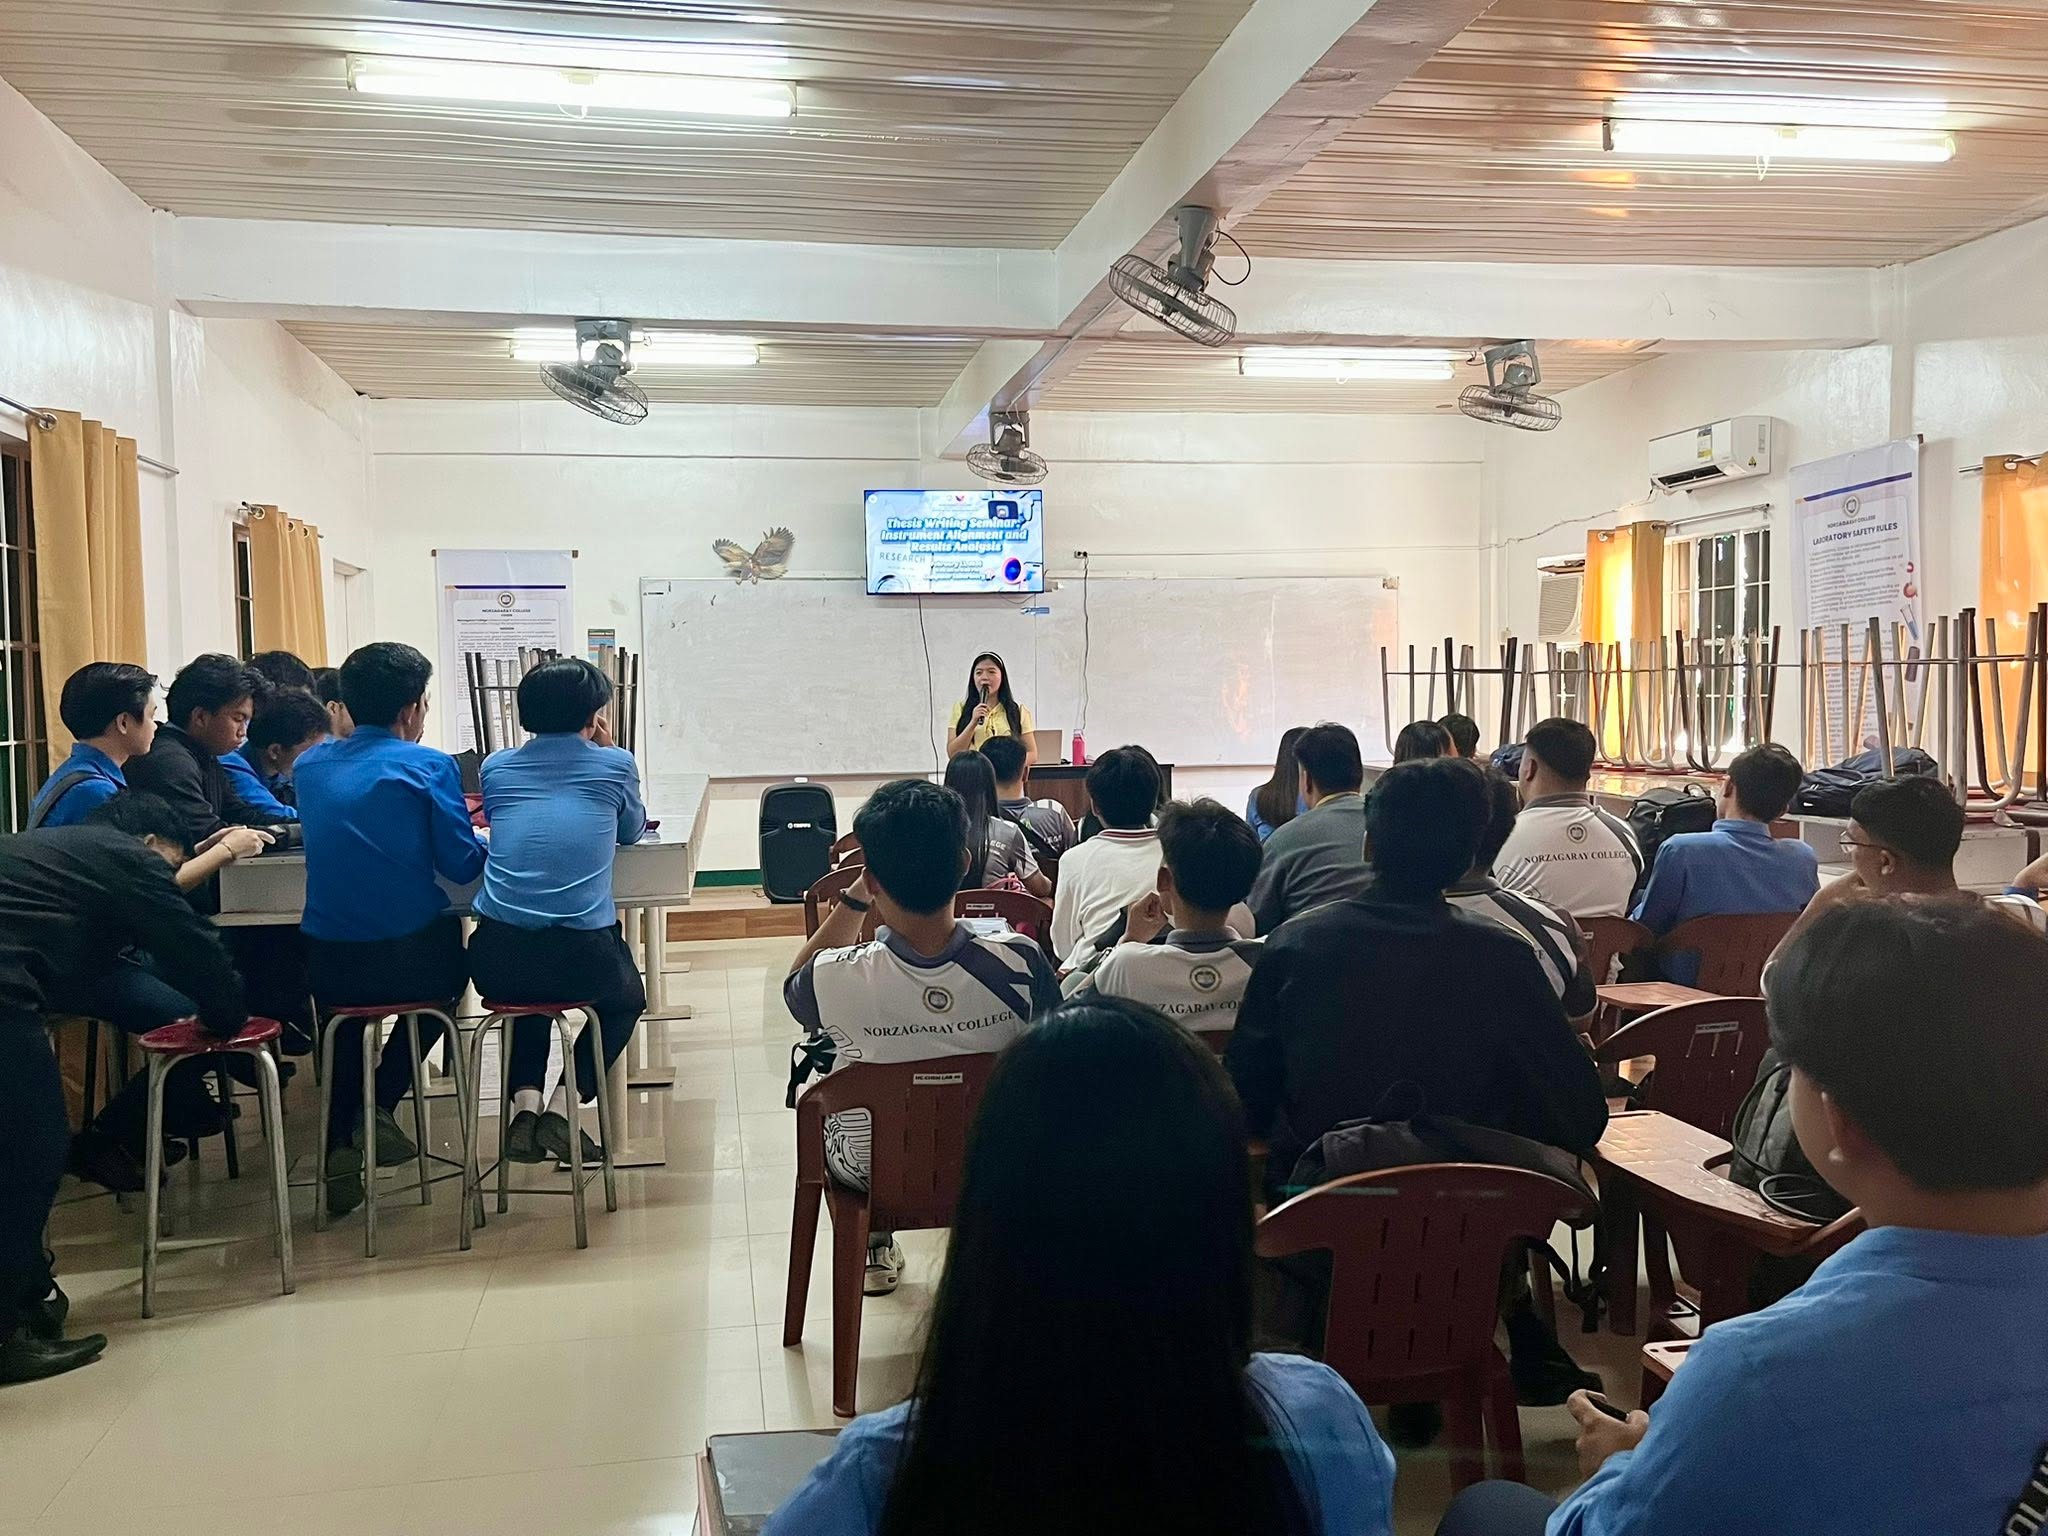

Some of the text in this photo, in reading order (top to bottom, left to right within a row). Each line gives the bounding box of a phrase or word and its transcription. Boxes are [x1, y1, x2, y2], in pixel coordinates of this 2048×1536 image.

[887, 518, 1021, 530] Thesis Writing Seminar:
[881, 530, 1028, 542] Instrument Alignment and
[1812, 522, 1898, 545] LABORATORY SAFETY RULES
[911, 542, 1003, 554] Results Analysis
[879, 552, 926, 563] RESEARCH
[1524, 851, 1630, 864] NORZAGARAY COLLEGE
[1154, 1002, 1216, 1014] ZAGARAY
[863, 1010, 1015, 1037] NORZAGARAY COLLEGE
